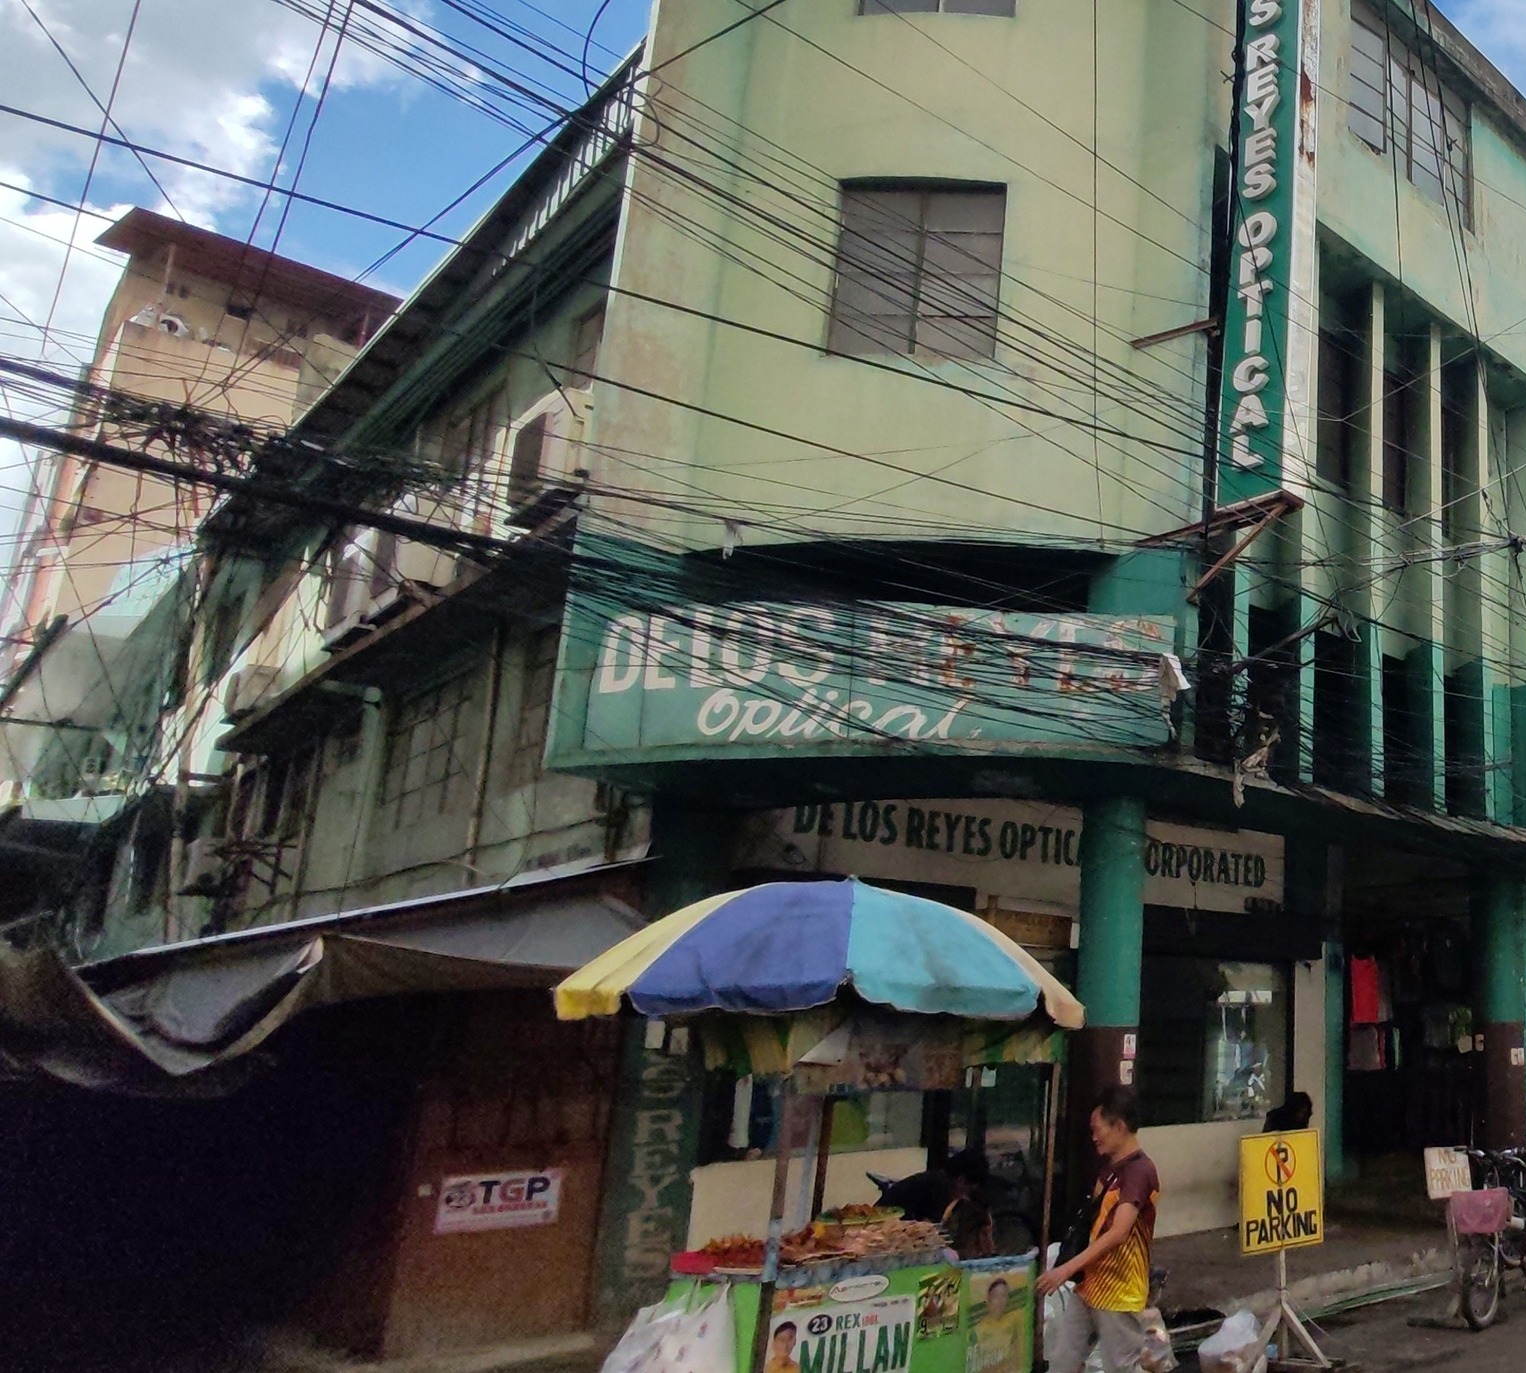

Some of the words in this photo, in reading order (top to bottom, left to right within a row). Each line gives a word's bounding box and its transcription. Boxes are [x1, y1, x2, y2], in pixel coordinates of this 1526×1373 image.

[1242, 33, 1281, 198] REYES
[1229, 211, 1277, 472] OPTICAL
[599, 606, 683, 693] DE
[689, 602, 836, 690] LOS
[867, 606, 1162, 694] REYES
[697, 686, 975, 742] Optical
[794, 802, 832, 836] DE
[842, 801, 897, 845] LOS
[905, 806, 992, 857] REYES
[1000, 821, 1080, 867] OPTIC
[1144, 839, 1266, 888] ORPORATED
[1437, 1150, 1457, 1164] NO
[478, 1176, 551, 1204] TGP
[1266, 1187, 1297, 1218] NO
[1246, 1210, 1317, 1247] PARKING
[800, 1321, 911, 1373] MILLAN
[812, 1317, 829, 1333] 23
[836, 1312, 861, 1331] REX
